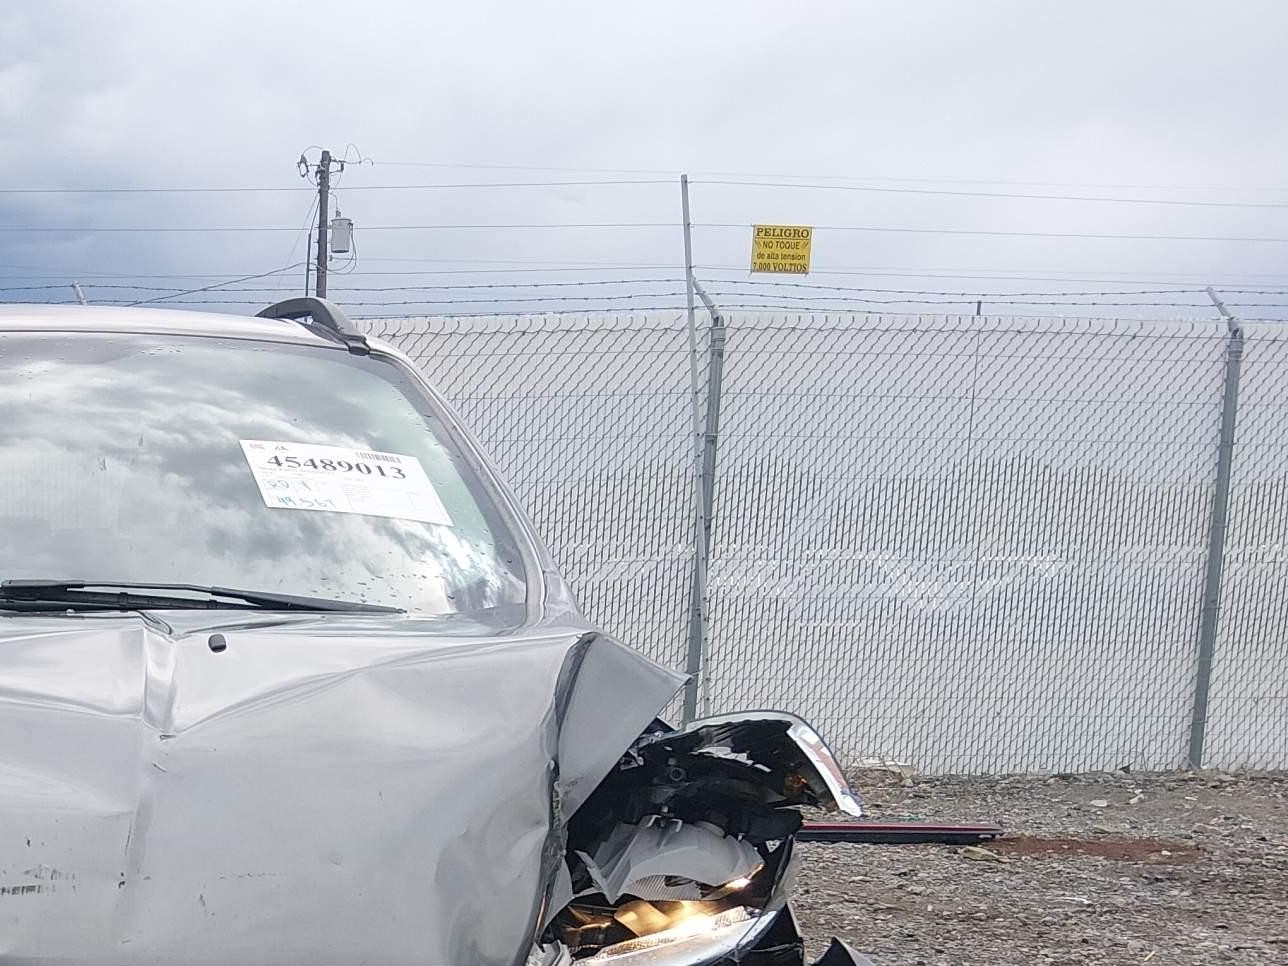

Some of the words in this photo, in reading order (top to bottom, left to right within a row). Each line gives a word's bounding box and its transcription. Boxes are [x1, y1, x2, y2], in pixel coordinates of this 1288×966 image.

[756, 227, 809, 238] PELIGRO
[762, 241, 773, 249] NO
[775, 241, 801, 250] TOQUE
[767, 252, 779, 260] alta
[780, 252, 806, 261] tension
[772, 263, 807, 272] VOLTIOS
[267, 455, 406, 480] 45489013
